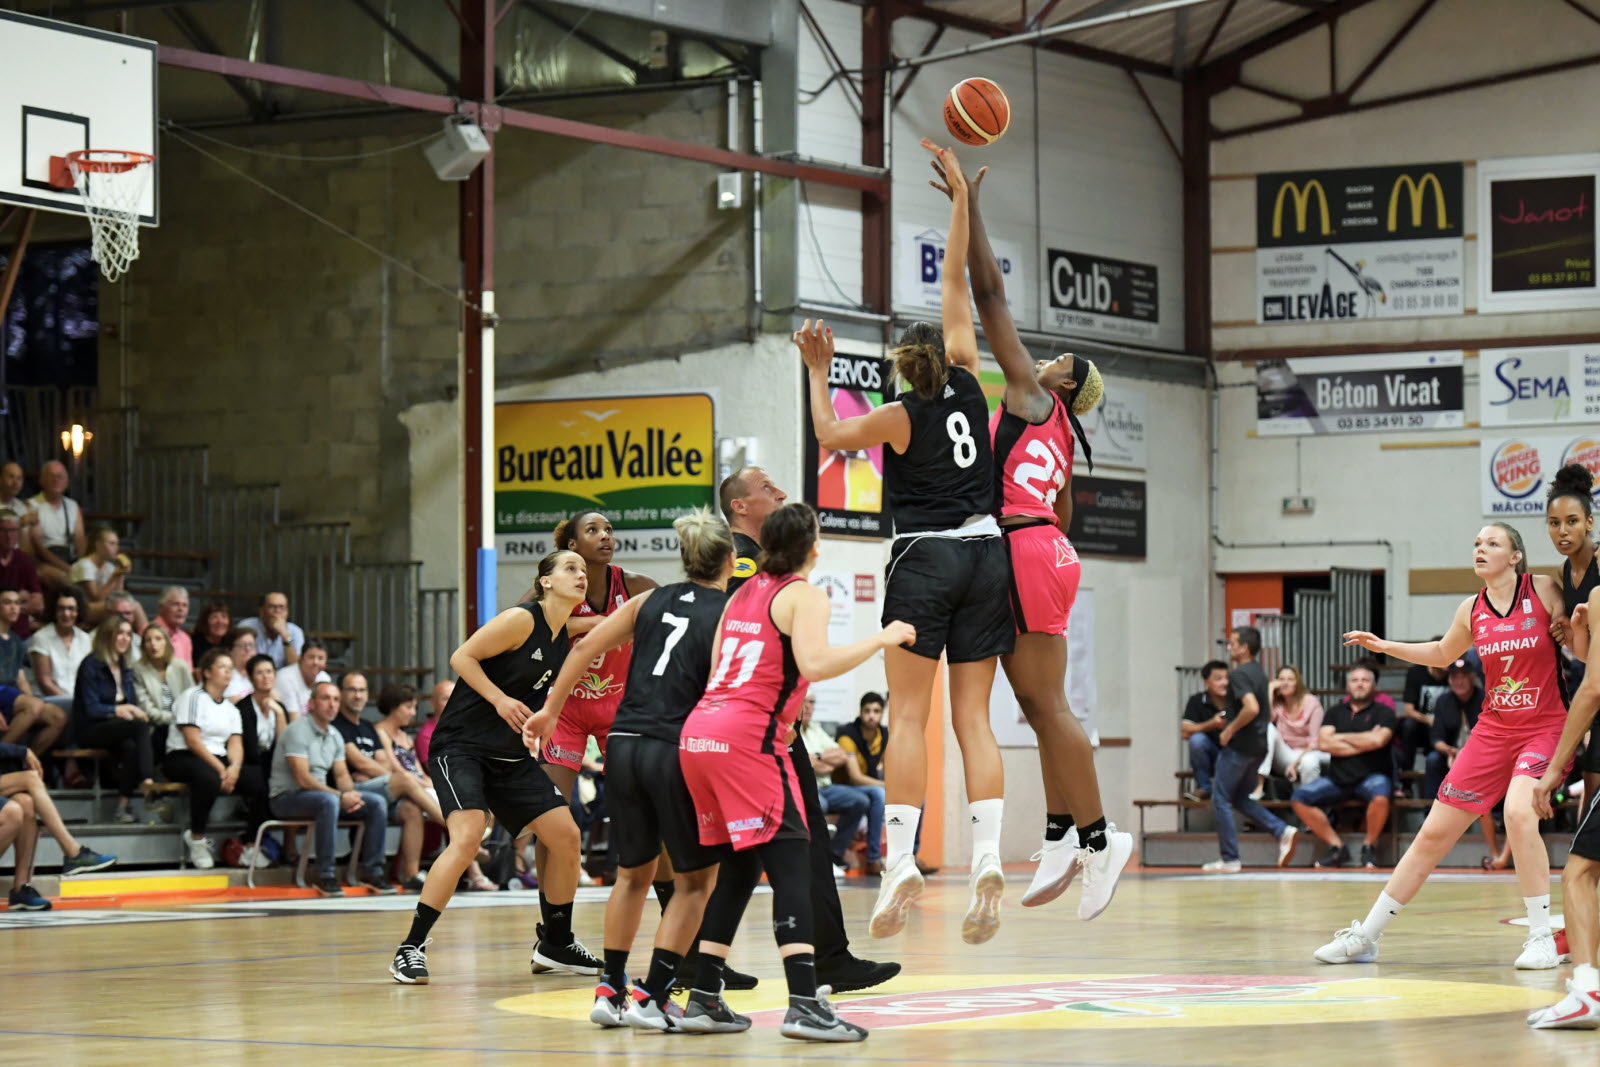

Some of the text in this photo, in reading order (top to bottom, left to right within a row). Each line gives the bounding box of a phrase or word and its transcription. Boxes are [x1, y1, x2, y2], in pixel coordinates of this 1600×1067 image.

[828, 357, 882, 389] ERVOS
[1317, 374, 1441, 410] Béton Vicat
[1338, 418, 1353, 429] 03
[1356, 417, 1370, 428] 85
[498, 427, 703, 483] Bureau Vallée
[946, 411, 978, 469] 8
[1047, 437, 1069, 471] MOORE
[1496, 448, 1539, 472] BURGER
[1497, 460, 1541, 488] KING
[498, 510, 513, 525] Le
[515, 509, 567, 525] discount
[624, 506, 657, 521] notre
[505, 540, 546, 555] RN6
[652, 612, 690, 677] 7
[1478, 636, 1539, 657] CHARNAY
[706, 636, 766, 691] 11
[1500, 655, 1515, 674] 7
